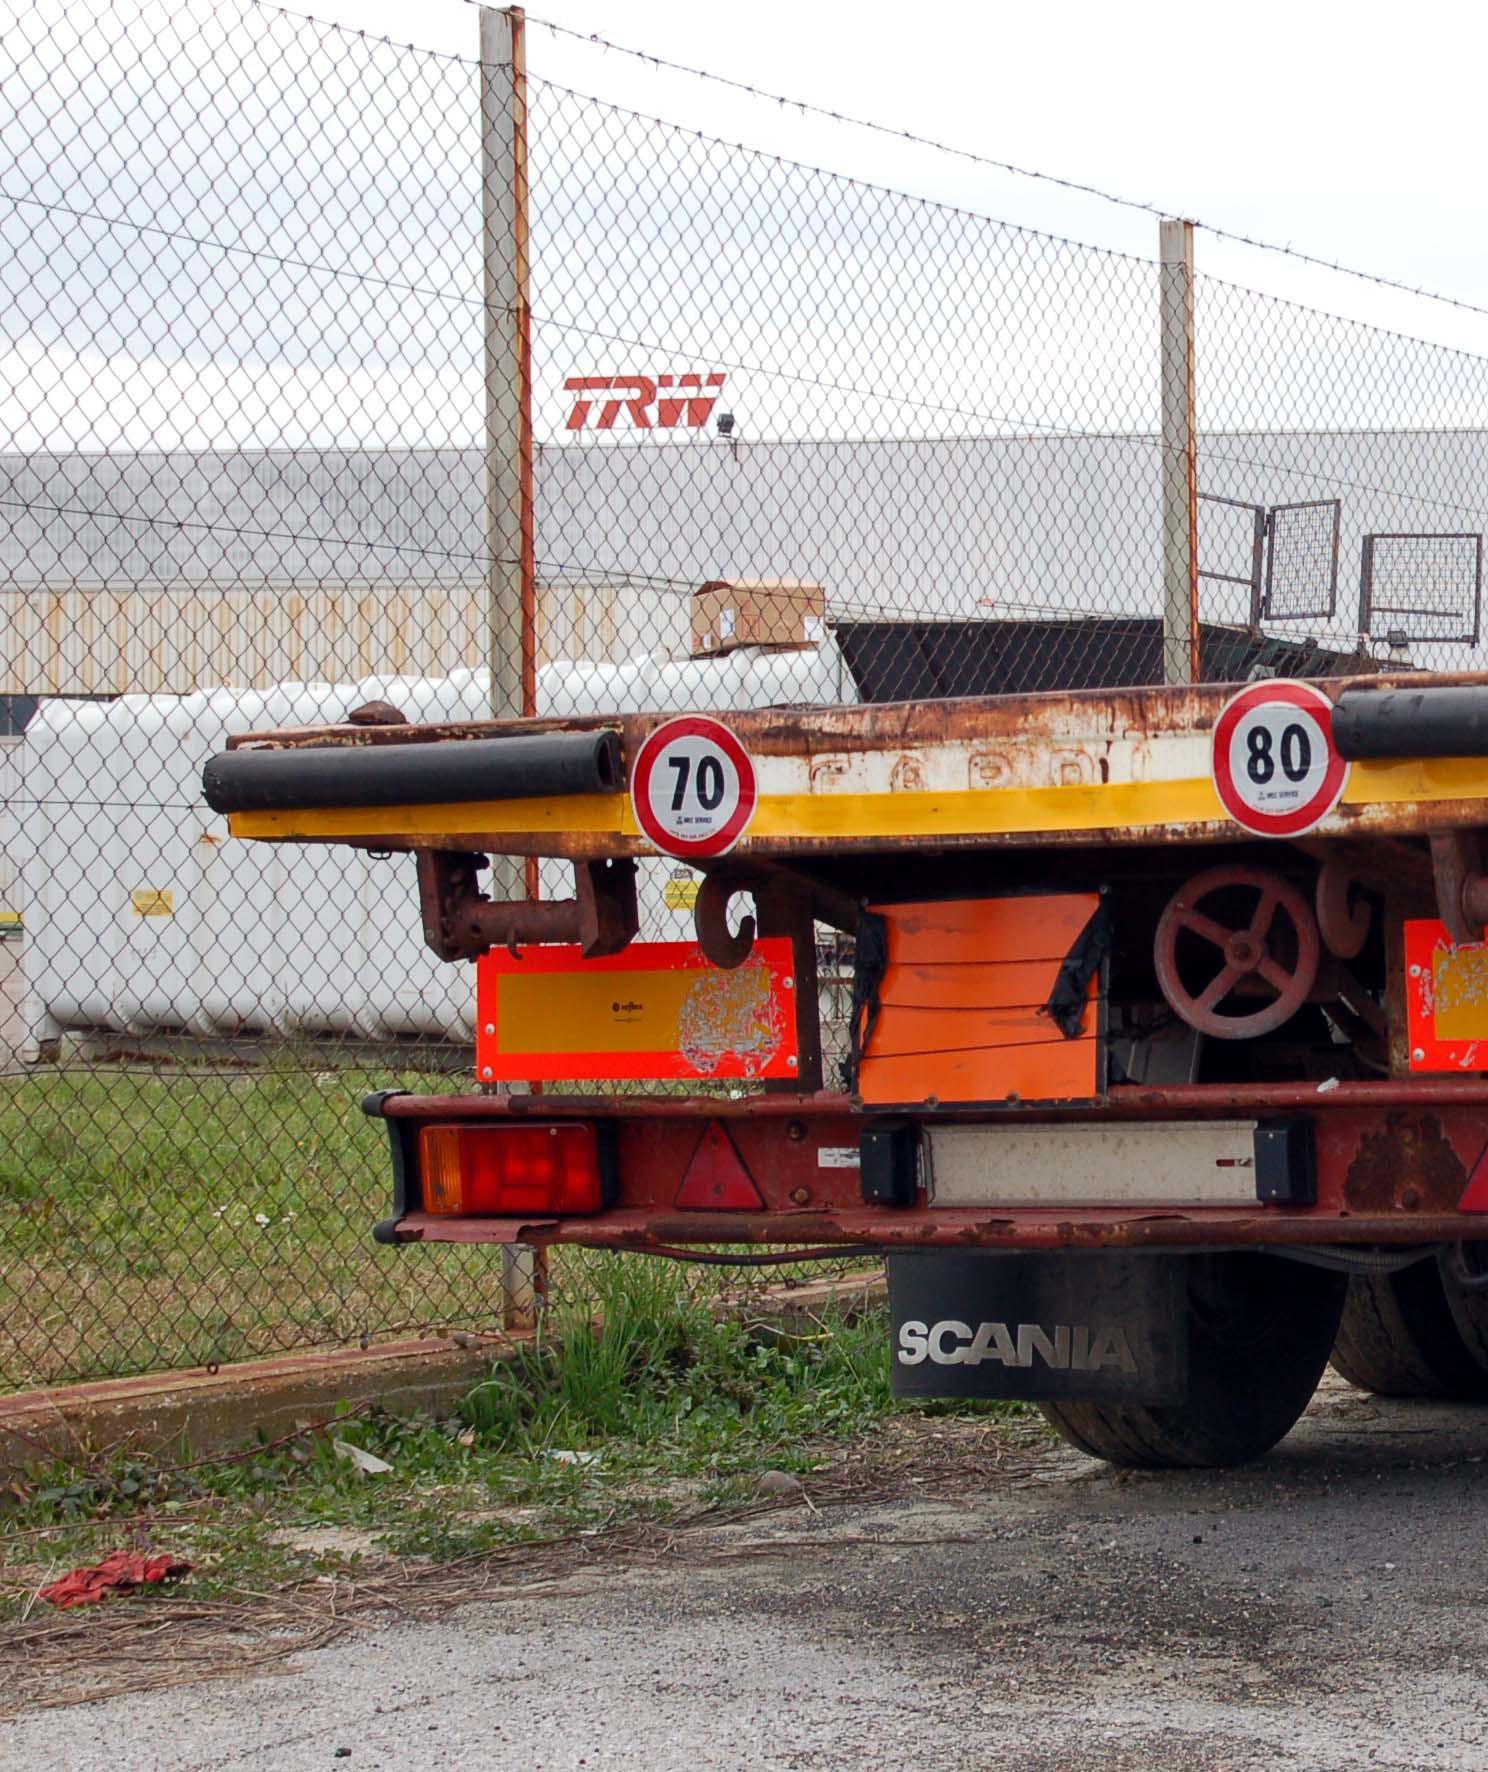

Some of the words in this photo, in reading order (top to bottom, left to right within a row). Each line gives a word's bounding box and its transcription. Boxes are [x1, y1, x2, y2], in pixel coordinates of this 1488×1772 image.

[563, 373, 727, 430] TRW
[1246, 723, 1312, 785] 80
[668, 755, 725, 811] 70
[898, 1320, 1138, 1373] SCANIA
